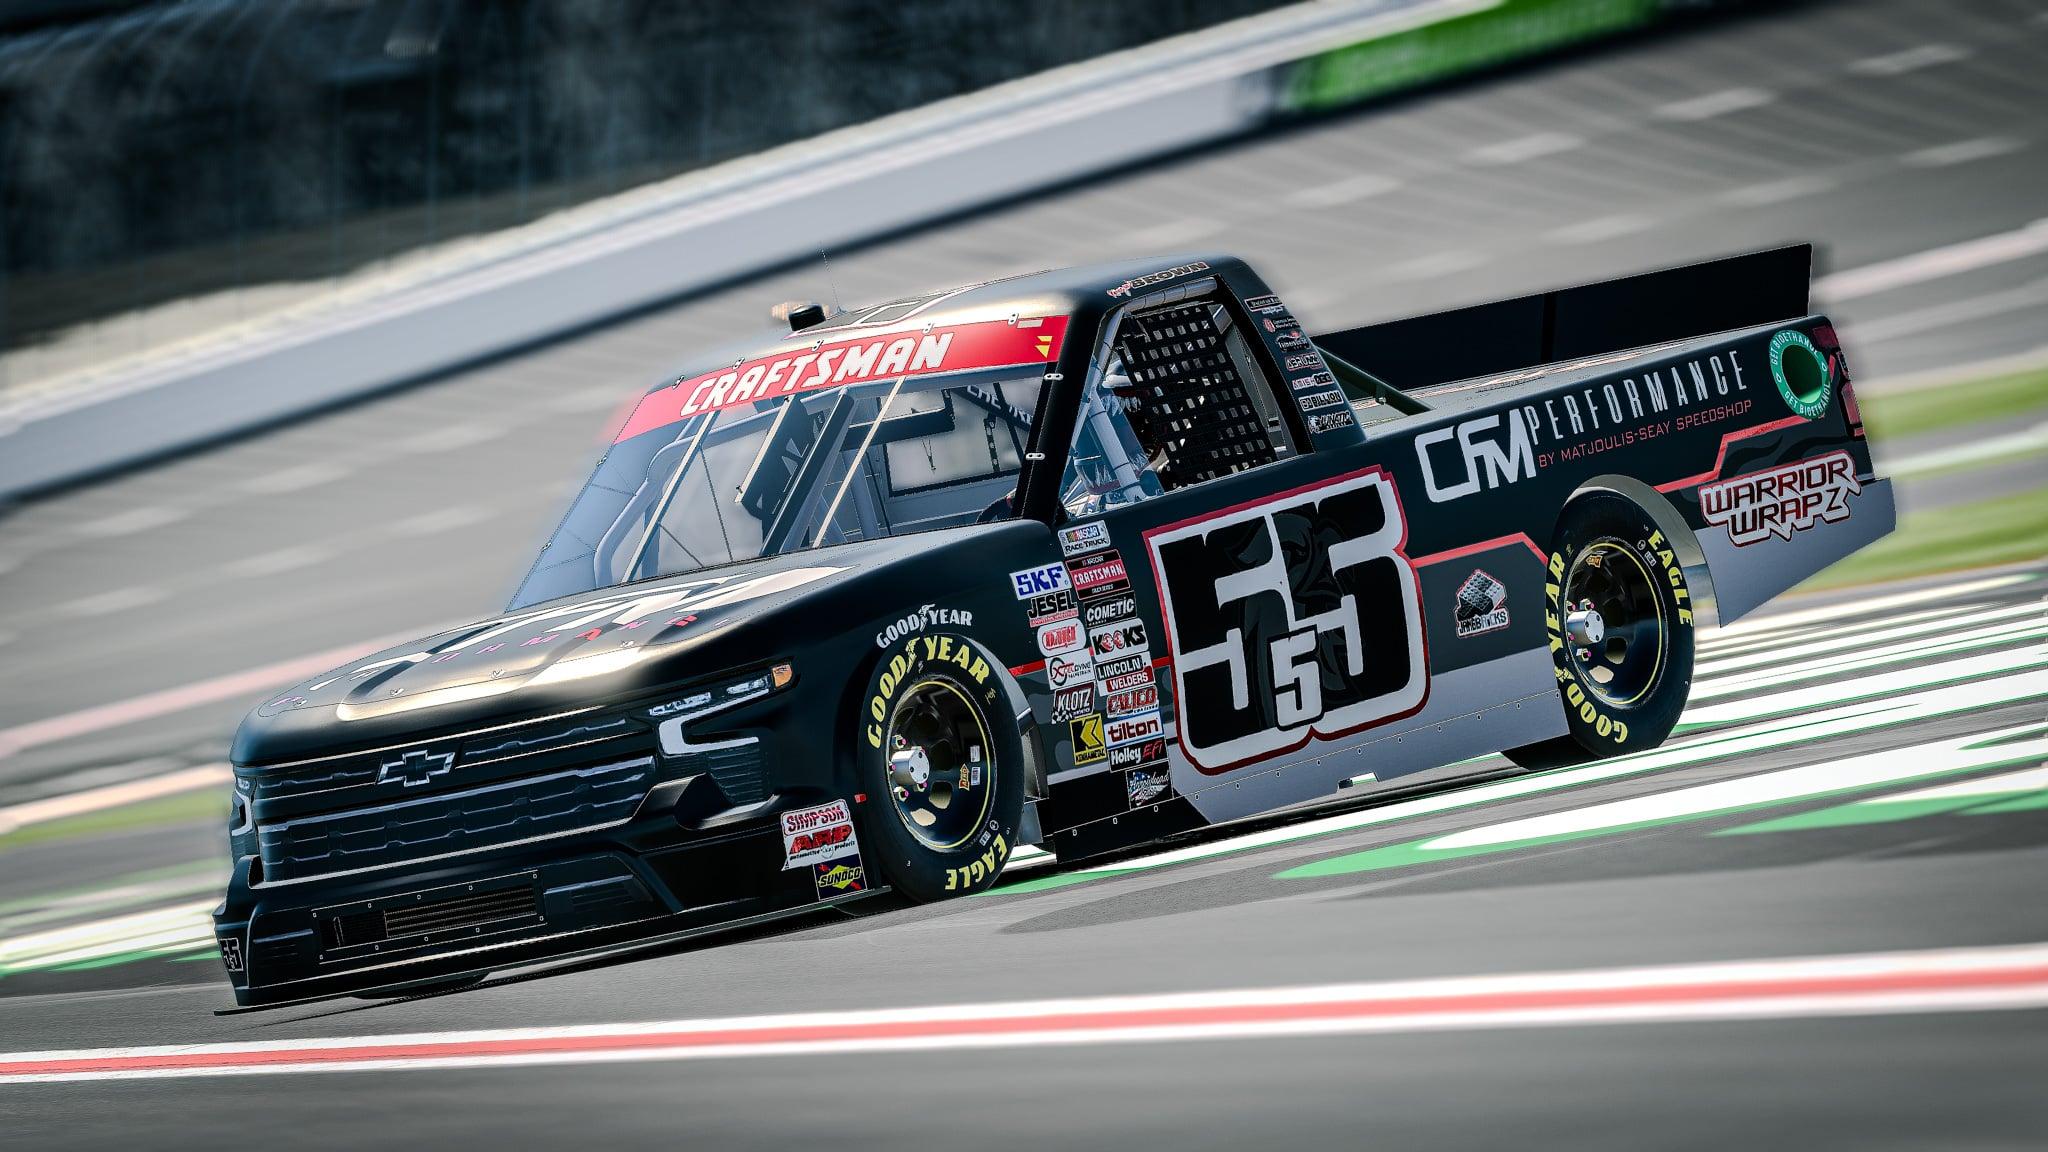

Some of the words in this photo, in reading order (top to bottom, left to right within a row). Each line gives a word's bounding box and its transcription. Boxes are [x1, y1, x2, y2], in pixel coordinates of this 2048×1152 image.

[1131, 261, 1211, 289] BROWN
[1770, 347, 1779, 365] GET
[680, 333, 953, 416] CRAFTSMAN
[1525, 351, 1747, 445] PERFORMANCE
[1785, 391, 1798, 408] GET
[1800, 383, 1831, 416] BIOETHANOL
[1539, 454, 1555, 468] BY
[1561, 421, 1671, 461] MATJOULIS-SEAY
[1677, 400, 1752, 430] SPEEDSHOP
[1703, 457, 1853, 516] WARRIOR
[1730, 487, 1843, 537] WRAPZ
[1065, 543, 1083, 552] RACE
[1083, 538, 1108, 548] TRUCK
[1074, 526, 1100, 540] NASCAR
[1016, 566, 1063, 596] SKF
[1073, 563, 1124, 586] CRAFTSMAN
[1648, 529, 1693, 627] EAGLE
[1027, 591, 1077, 618] JESEL
[1086, 597, 1135, 622] COMETIC
[1152, 475, 1420, 762] 55
[1093, 624, 1145, 656] KOOKS
[1097, 657, 1141, 679] LINCOLN
[1110, 672, 1148, 690] WELDERS
[1270, 630, 1323, 728] 5
[1057, 688, 1092, 712] KLOTZ
[1107, 719, 1159, 742] tilton
[1111, 747, 1141, 765] Holley
[1143, 740, 1163, 760] EFI
[786, 805, 845, 832] SIMPSON
[789, 824, 852, 854] ARP
[945, 833, 1008, 890] EAGLE
[818, 867, 862, 887] SUNOCO
